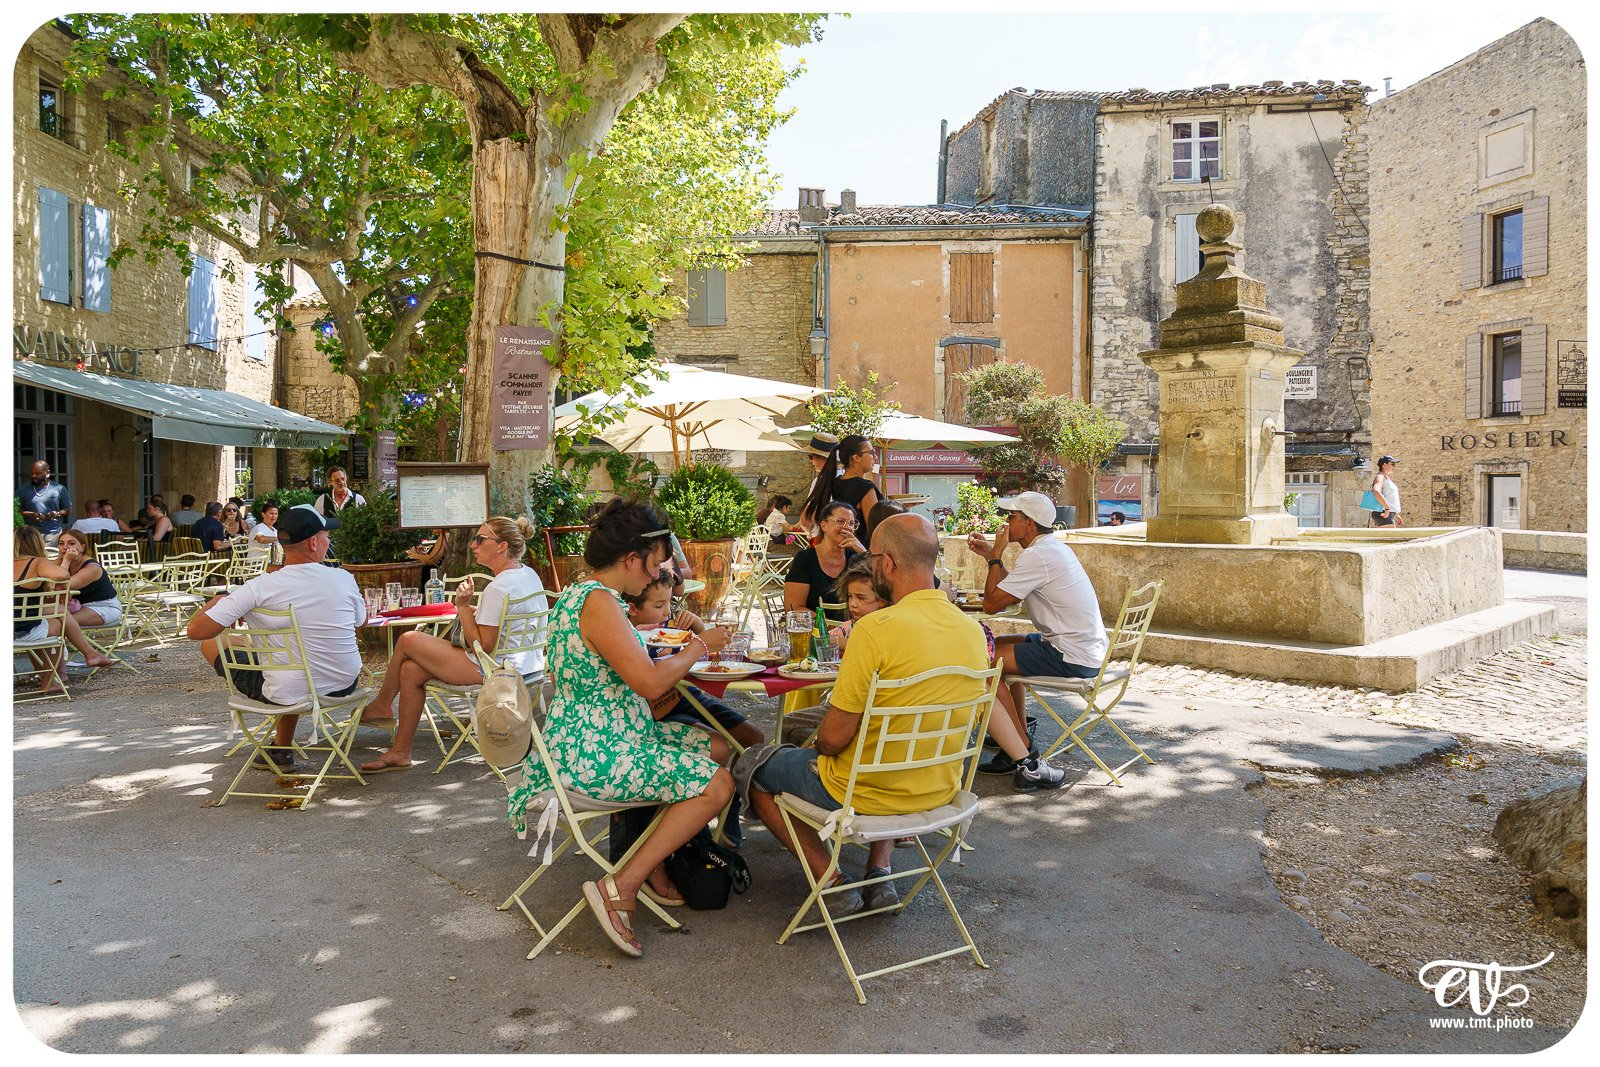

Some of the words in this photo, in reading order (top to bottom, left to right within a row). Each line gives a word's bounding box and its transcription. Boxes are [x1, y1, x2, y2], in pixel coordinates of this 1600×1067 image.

[510, 338, 550, 346] RENAISSANCE
[504, 346, 543, 356] Restaura
[1441, 430, 1570, 450] ROSIER
[694, 454, 730, 462] GORDES
[1100, 476, 1138, 494] Art
